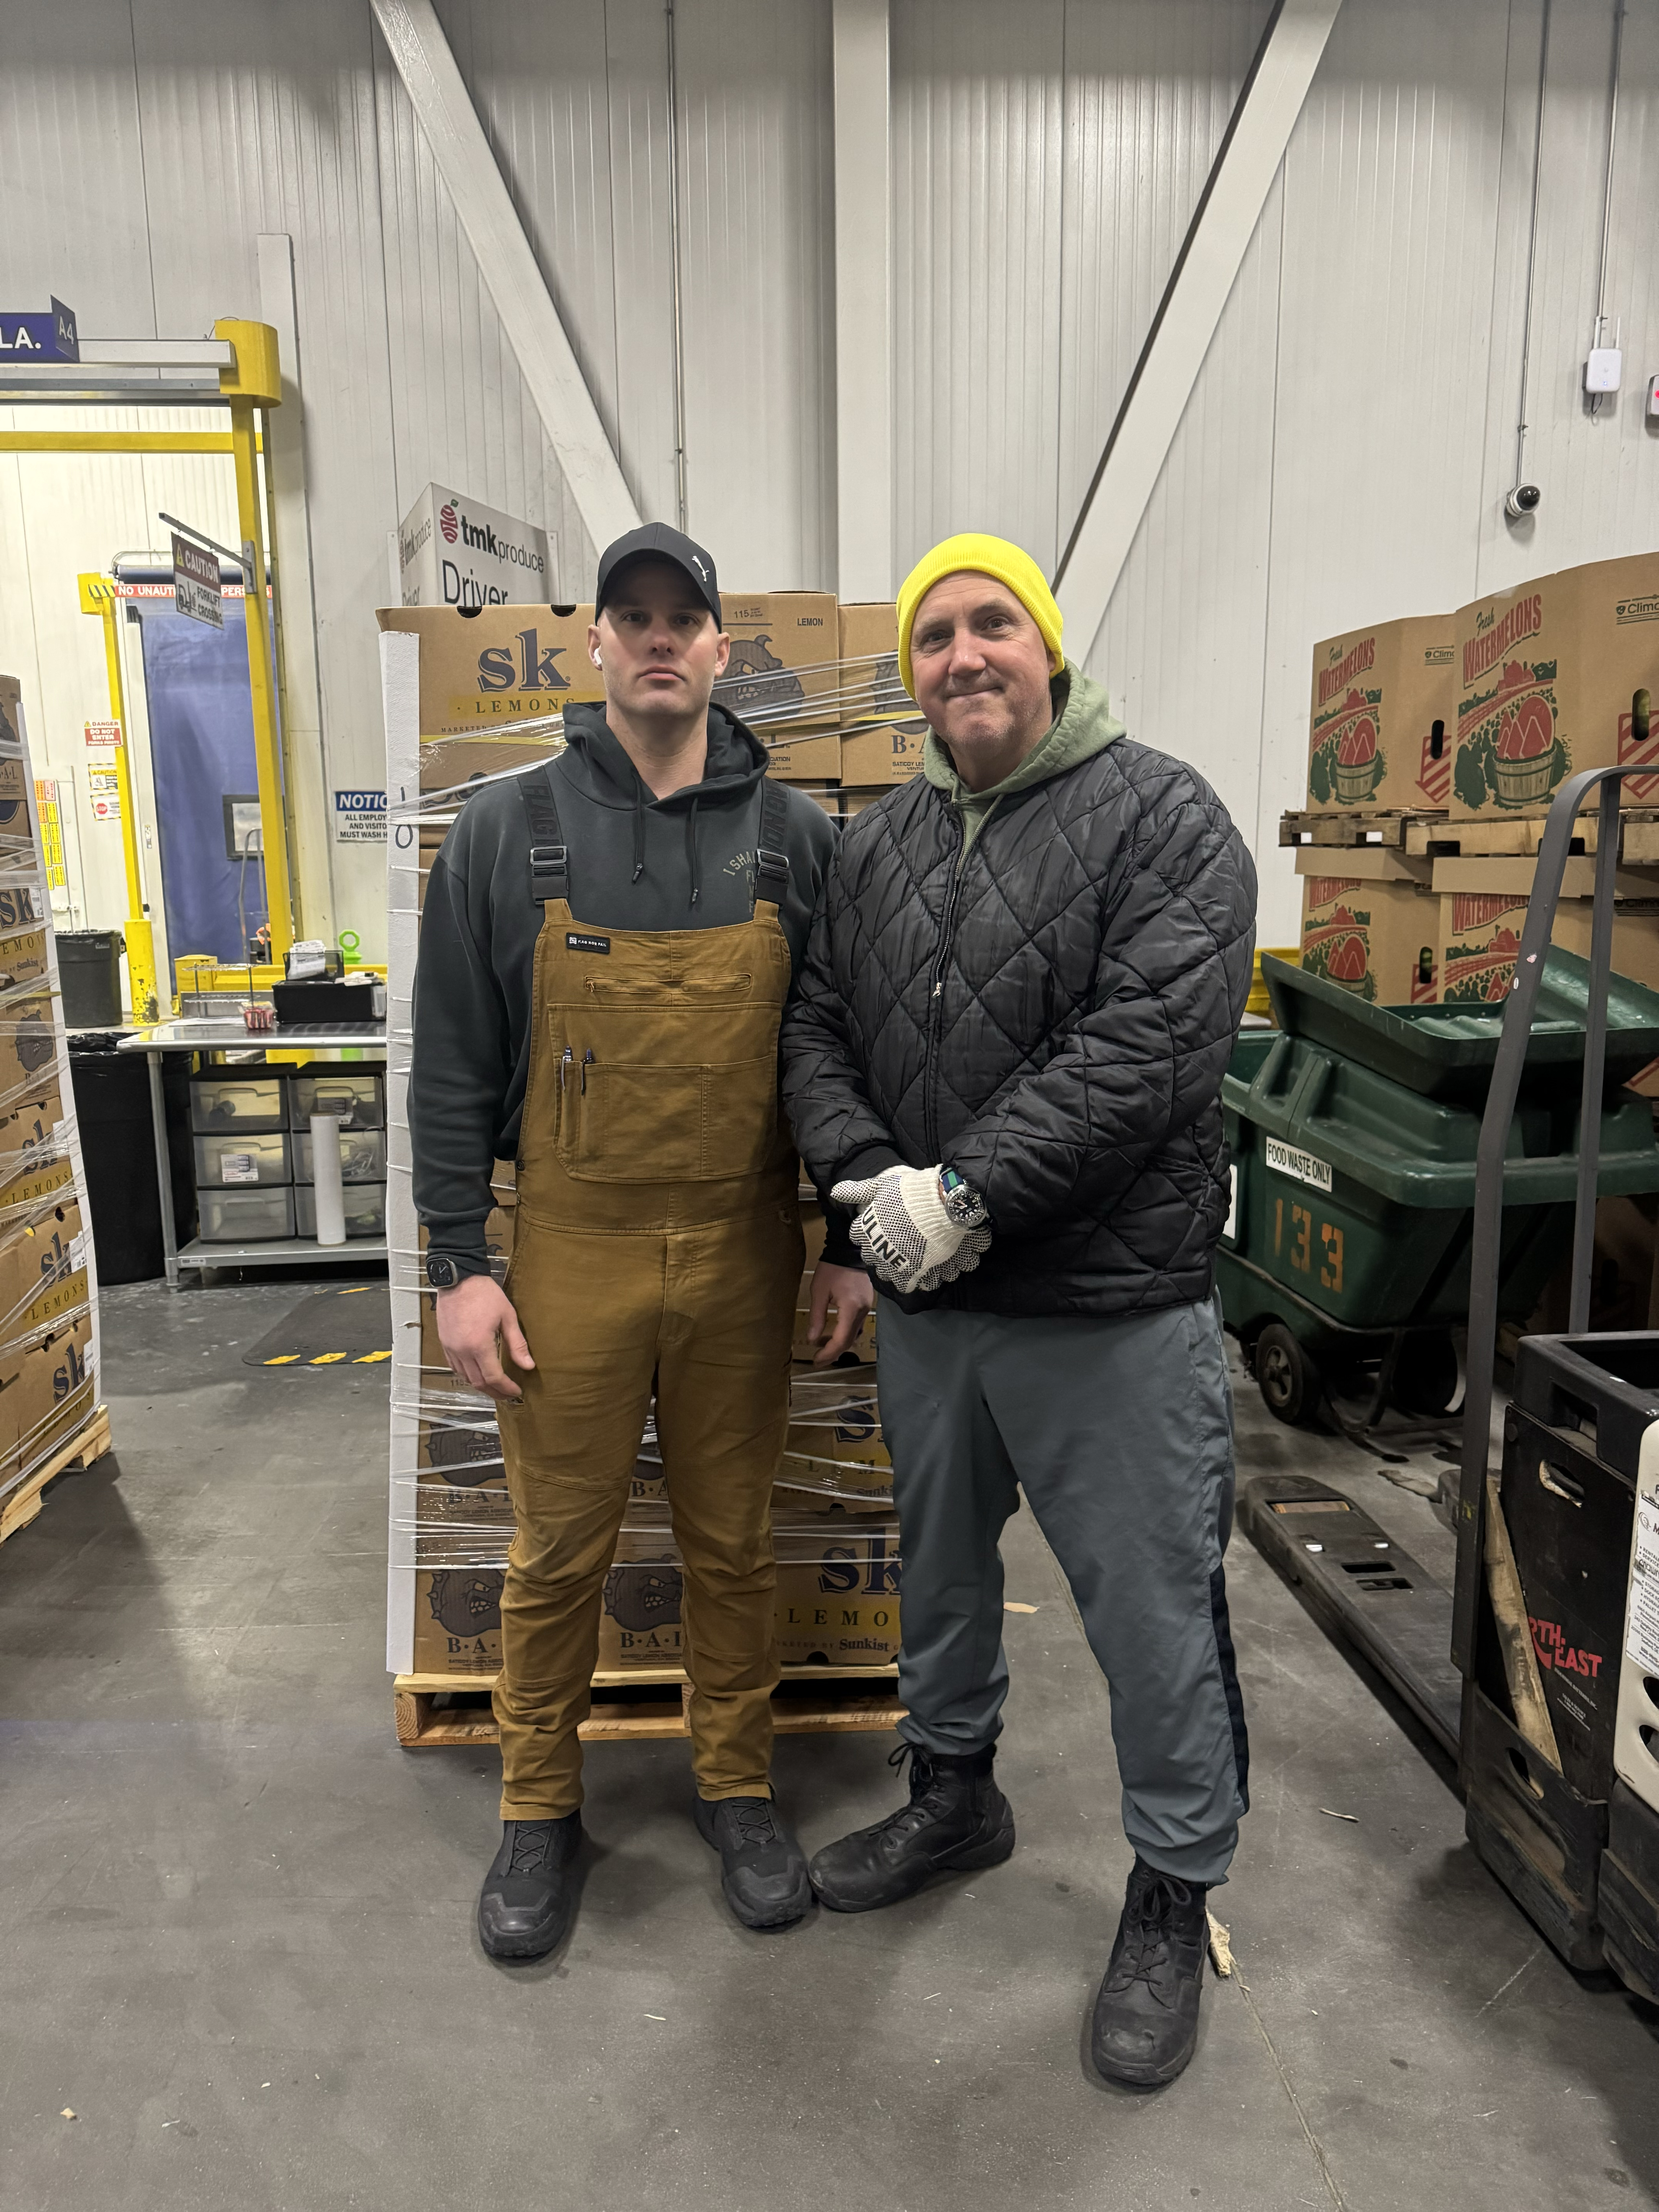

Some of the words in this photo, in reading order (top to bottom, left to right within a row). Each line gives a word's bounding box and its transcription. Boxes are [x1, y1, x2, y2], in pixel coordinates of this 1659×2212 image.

[59, 316, 74, 345] A4
[461, 515, 544, 573] tmkproduce
[185, 550, 218, 583] CAUTION
[443, 560, 508, 605] Driver
[118, 586, 134, 596] NO
[137, 586, 175, 596] UNAUT
[197, 586, 220, 608] FORKLIFT
[198, 603, 222, 624] CROSSING
[734, 610, 749, 618] 115
[1477, 607, 1495, 634] Fresh
[1463, 594, 1542, 689] WATERMELONS
[1318, 637, 1375, 707] WATERMELONS
[1268, 1144, 1286, 1165] FOOD
[1288, 1152, 1310, 1175] WASTE
[1312, 1162, 1331, 1184] ONLY
[12, 1171, 68, 1205] LEMONS
[862, 1207, 906, 1268] ULINE
[1275, 1199, 1343, 1293] 133
[32, 1279, 84, 1320] LEMONS
[839, 1638, 890, 1652] Sunkist
[1554, 1647, 1602, 1678] EAST
